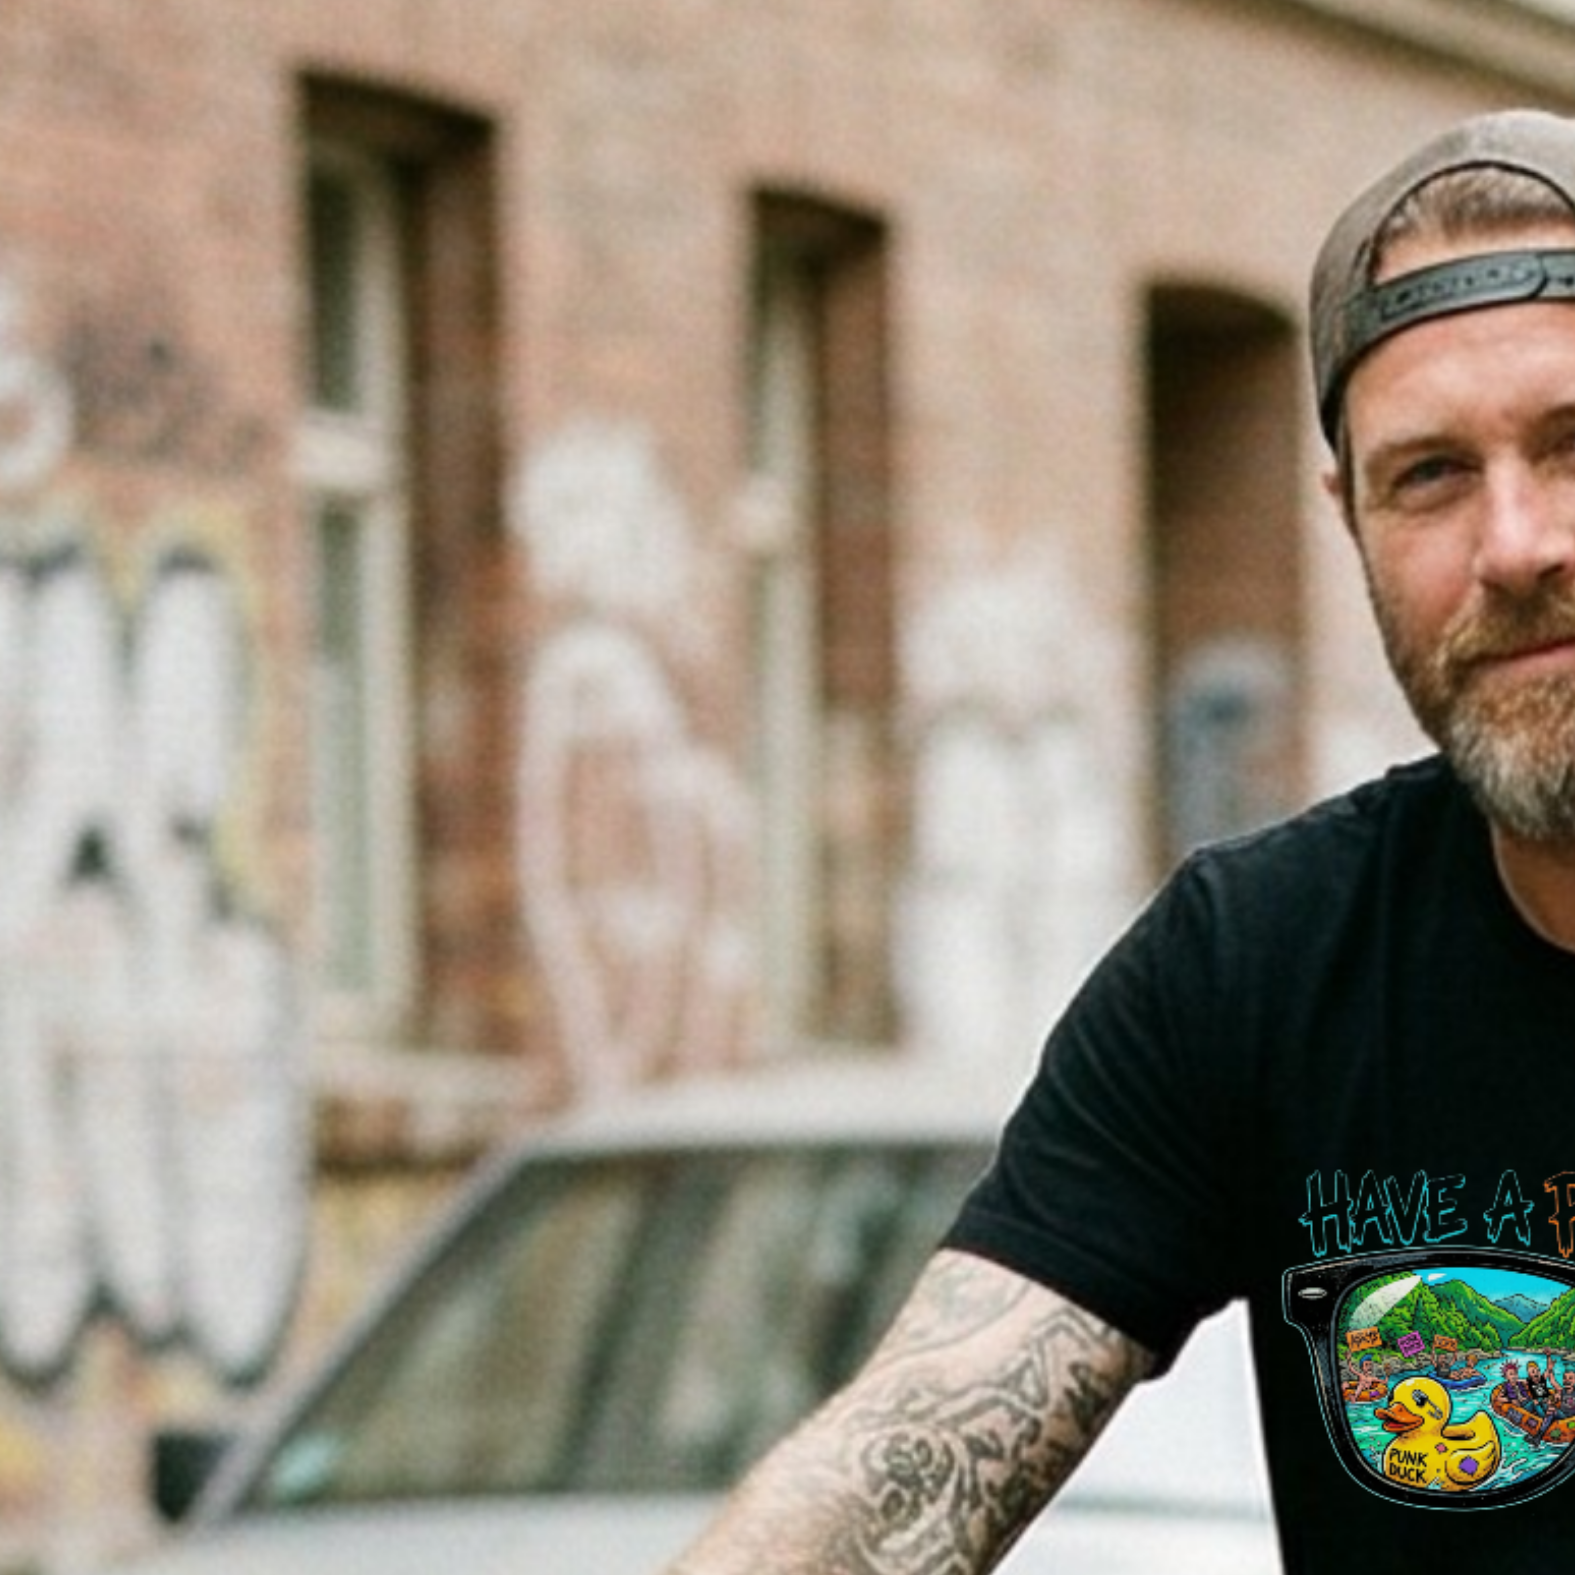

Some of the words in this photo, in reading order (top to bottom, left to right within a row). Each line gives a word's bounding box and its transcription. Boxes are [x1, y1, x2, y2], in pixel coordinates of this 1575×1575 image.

[1298, 1169, 1468, 1257] HAVE
[1483, 1169, 1535, 1246] A
[1389, 1448, 1429, 1467] PUNK
[1389, 1462, 1428, 1484] DUCK
